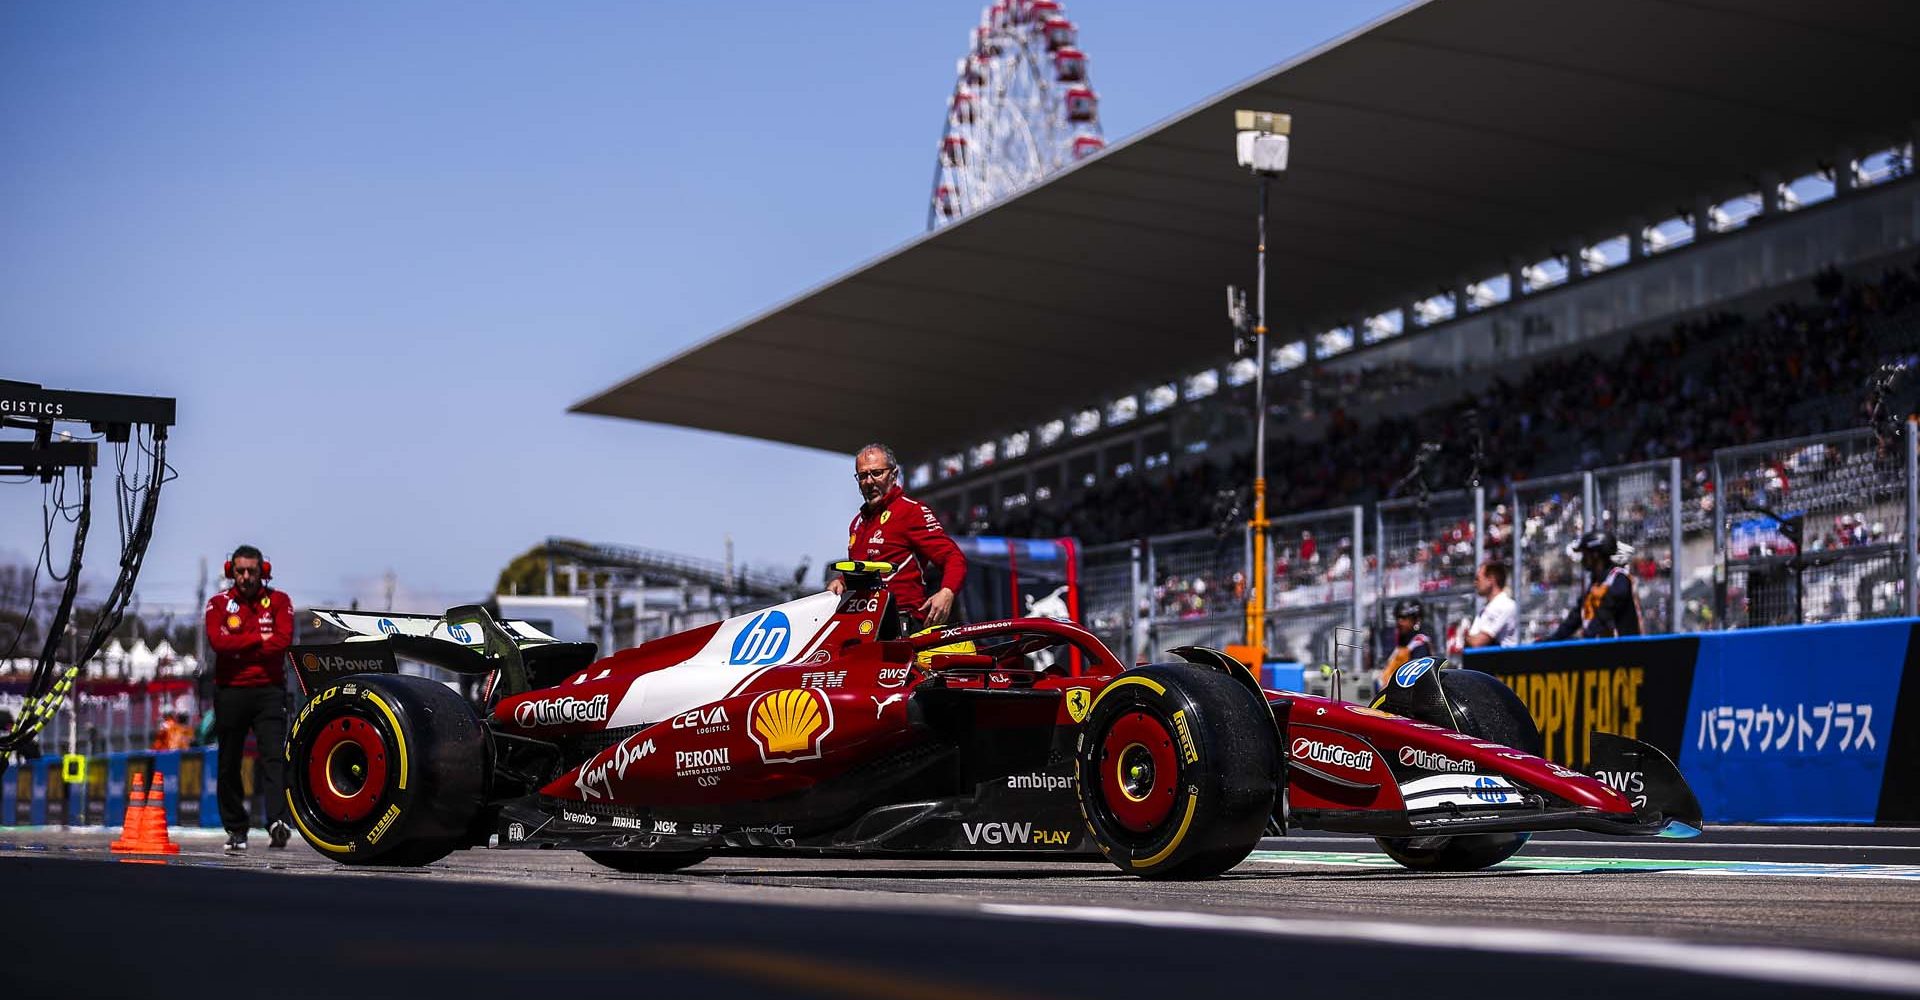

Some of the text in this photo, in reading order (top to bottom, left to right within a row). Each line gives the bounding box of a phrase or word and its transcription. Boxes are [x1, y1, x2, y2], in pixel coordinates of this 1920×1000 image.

[0, 400, 63, 414] GISTICS
[447, 624, 472, 643] hp
[730, 610, 791, 665] hp
[940, 621, 1012, 639] DXC TECHNOLOGY
[319, 656, 383, 671] V-Power
[879, 667, 907, 680] aws
[1397, 658, 1434, 687] hp
[292, 686, 337, 739] ZERO
[534, 695, 608, 725] UniCredit
[1496, 666, 1644, 767] PPY FACE
[696, 725, 730, 734] LOGISTICS
[1173, 710, 1199, 764] PIRELLI
[1698, 701, 1876, 753] パラマウントプラス
[675, 748, 730, 769] PERONI
[1310, 742, 1373, 771] UniCredit
[1415, 750, 1476, 773] UniCredit
[677, 765, 731, 777] NASTRO AZZURRO
[1594, 771, 1644, 792] aws
[1007, 773, 1073, 791] ambipar
[1475, 777, 1507, 803] hp
[366, 803, 401, 844] PIRELLI
[563, 809, 597, 826] brembo
[611, 817, 641, 829] MAHLE
[653, 820, 677, 833] NGK
[962, 822, 1070, 845] VGW PLAY
